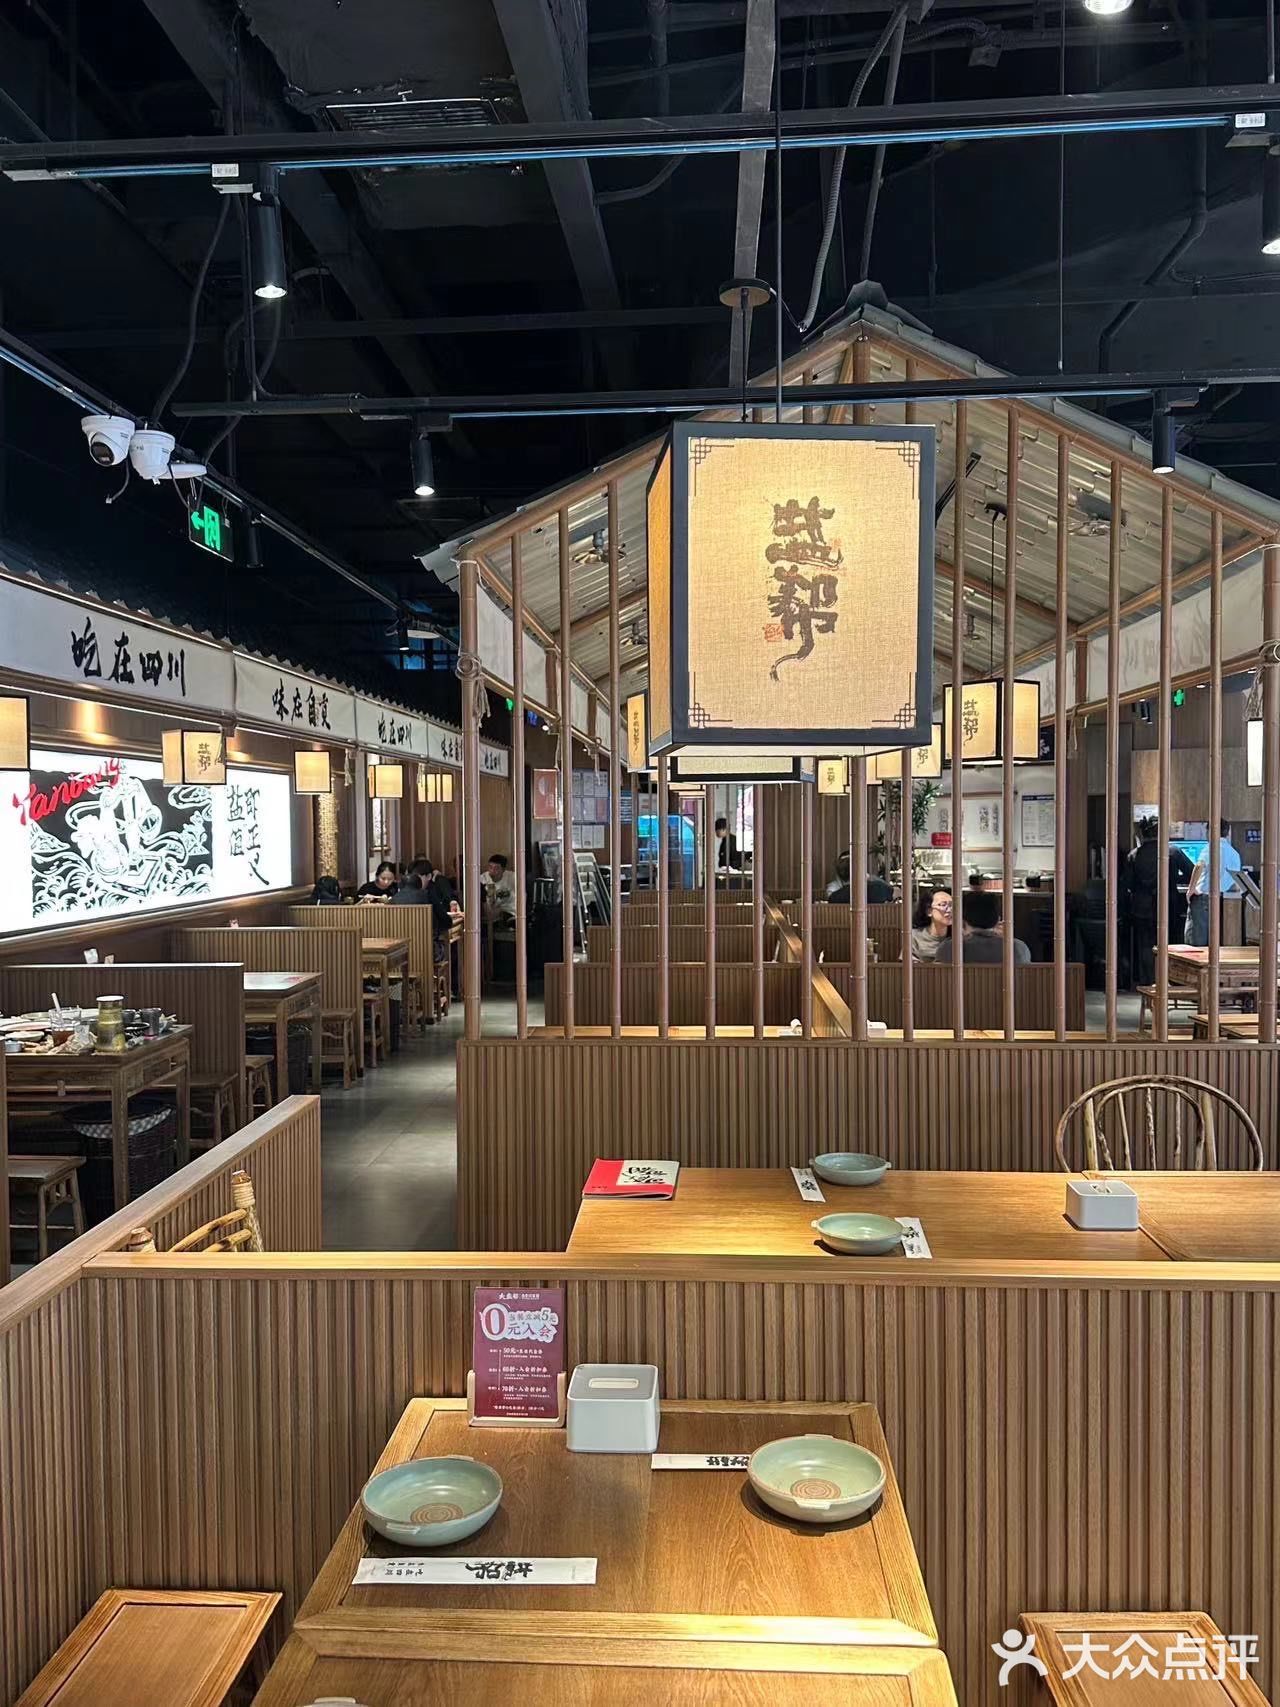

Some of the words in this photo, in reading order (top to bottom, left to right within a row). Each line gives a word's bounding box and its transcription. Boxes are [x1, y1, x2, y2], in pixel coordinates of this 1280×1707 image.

[71, 616, 186, 697] 吃在四川
[272, 678, 332, 731] 味在自贡
